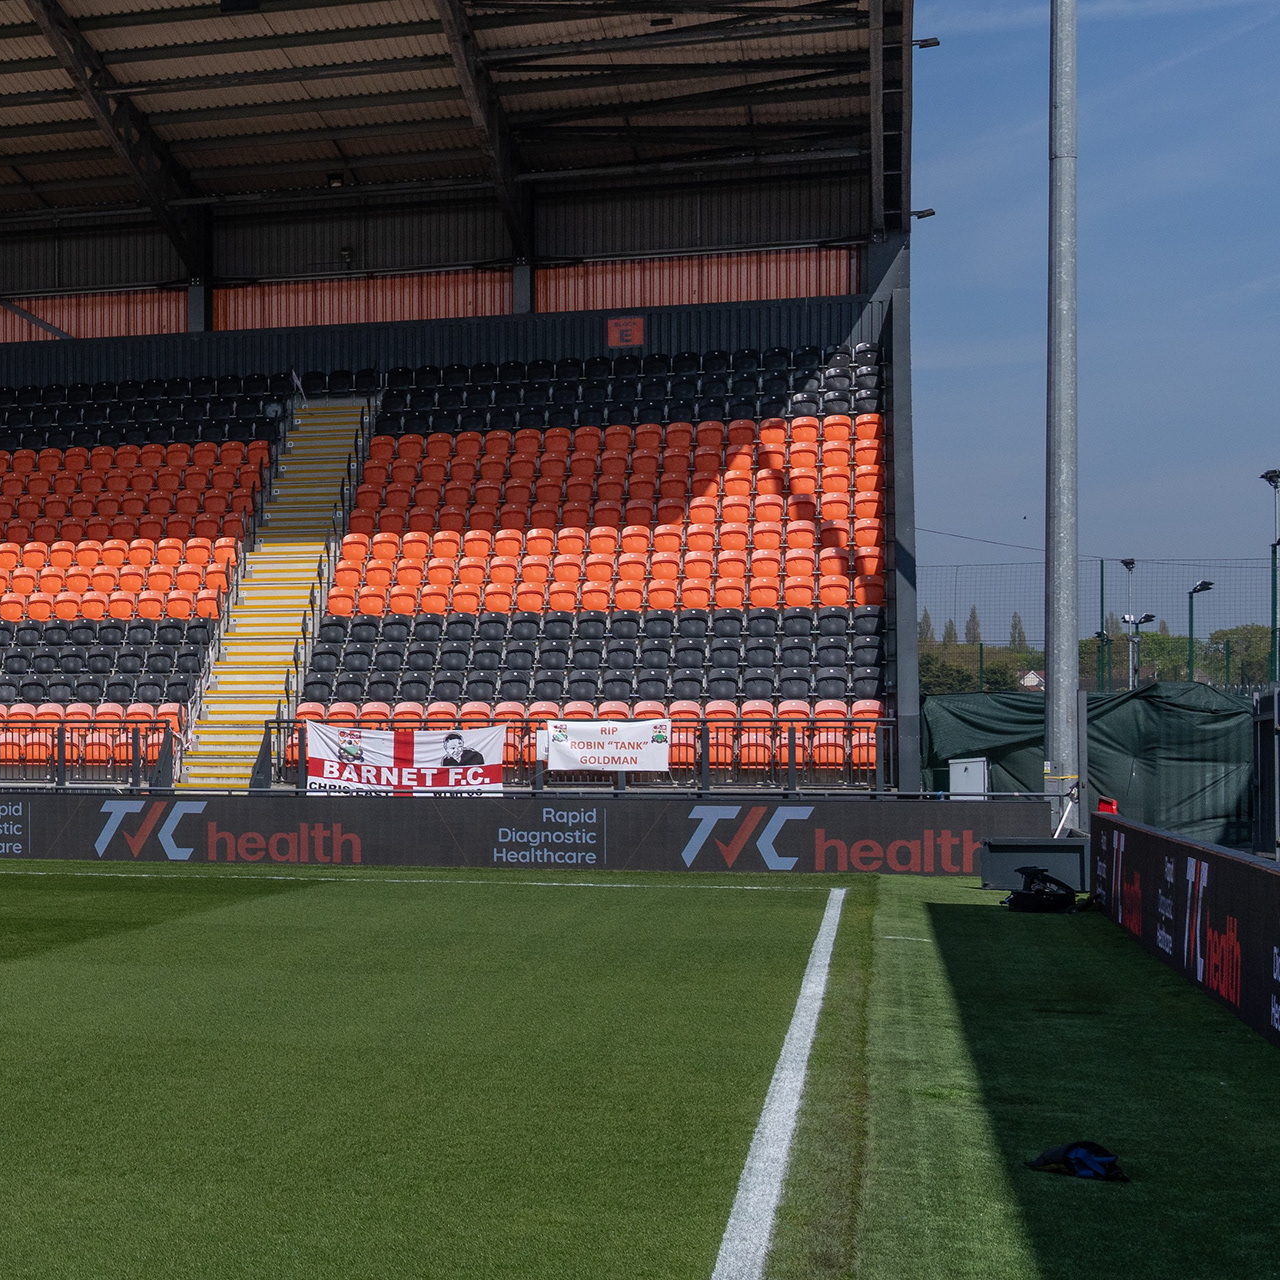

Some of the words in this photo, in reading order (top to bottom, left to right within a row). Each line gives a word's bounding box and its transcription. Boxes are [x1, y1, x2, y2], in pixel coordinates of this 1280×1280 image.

[620, 329, 632, 342] E
[600, 727, 618, 735] RIP
[570, 741, 605, 750] ROBIN
[580, 756, 638, 765] GOLDMAN
[323, 761, 437, 786] BARNET
[449, 767, 490, 786] F.C.
[542, 807, 597, 827] Rapid
[207, 822, 362, 864] health
[498, 827, 597, 847] Diagnostic
[493, 846, 597, 864] Healthcare
[1205, 907, 1241, 1008] health
